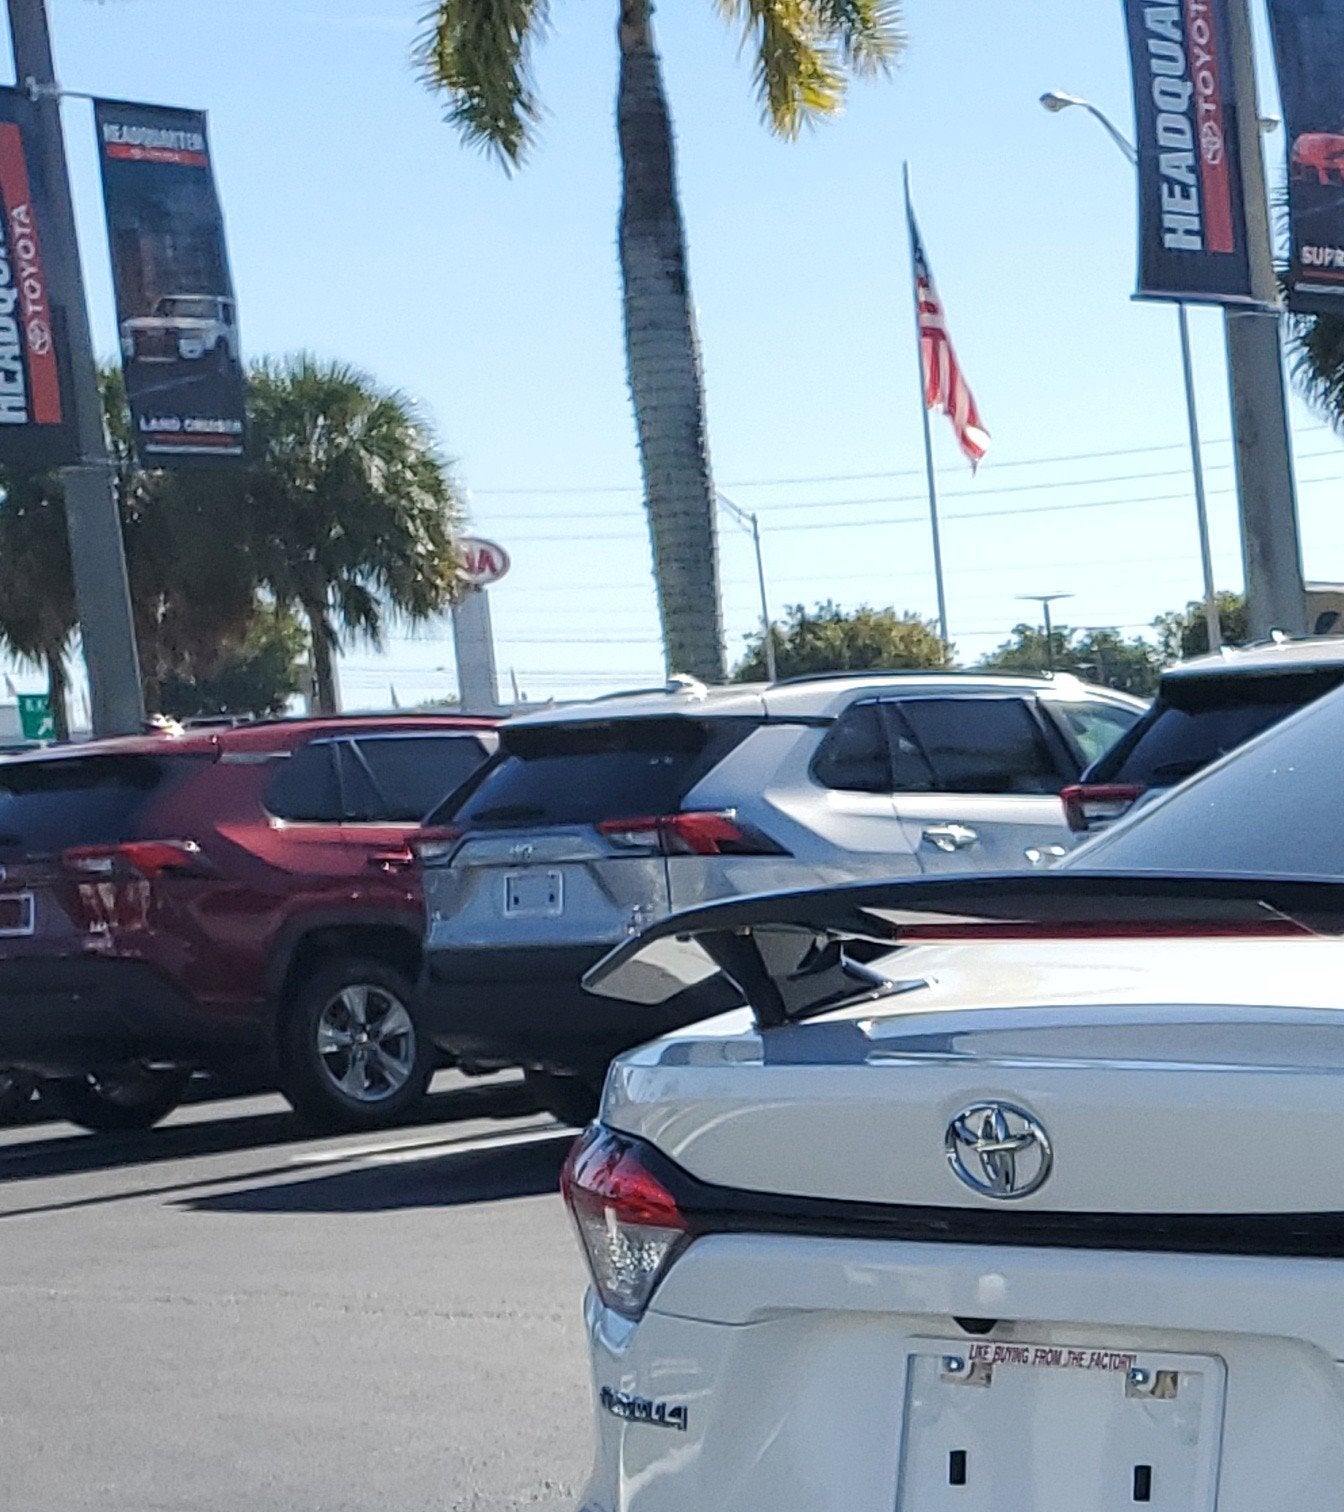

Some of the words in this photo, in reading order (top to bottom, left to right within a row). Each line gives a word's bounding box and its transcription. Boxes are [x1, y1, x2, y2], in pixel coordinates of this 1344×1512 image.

[1142, 0, 1202, 251] HEADQUA
[11, 204, 43, 316] TOYOTA
[969, 1344, 990, 1361] LIKE
[993, 1345, 1029, 1364] BUYING
[1033, 1349, 1061, 1367] FROM
[1063, 1351, 1085, 1368] THE
